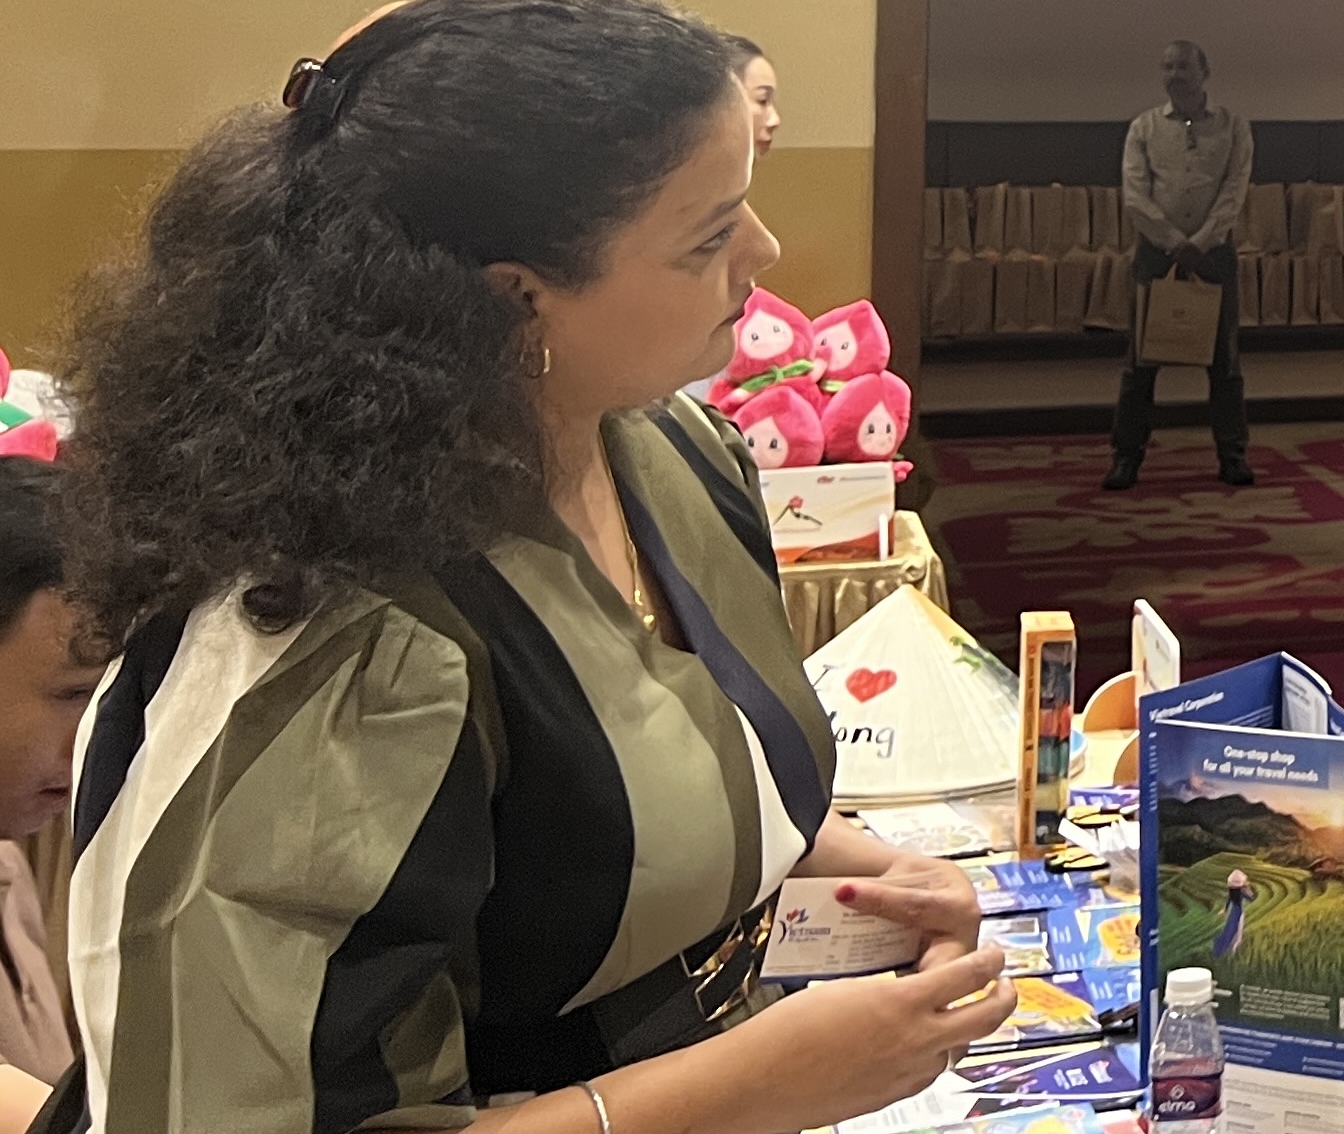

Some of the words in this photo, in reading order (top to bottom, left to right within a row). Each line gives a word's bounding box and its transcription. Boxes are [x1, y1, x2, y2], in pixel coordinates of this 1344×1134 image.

[1223, 745, 1269, 764] One-stop
[1270, 749, 1295, 766] shop
[1203, 758, 1218, 771] for
[1218, 761, 1231, 774] all
[1233, 765, 1255, 778] your
[1256, 766, 1287, 779] travel
[1287, 769, 1319, 782] needs
